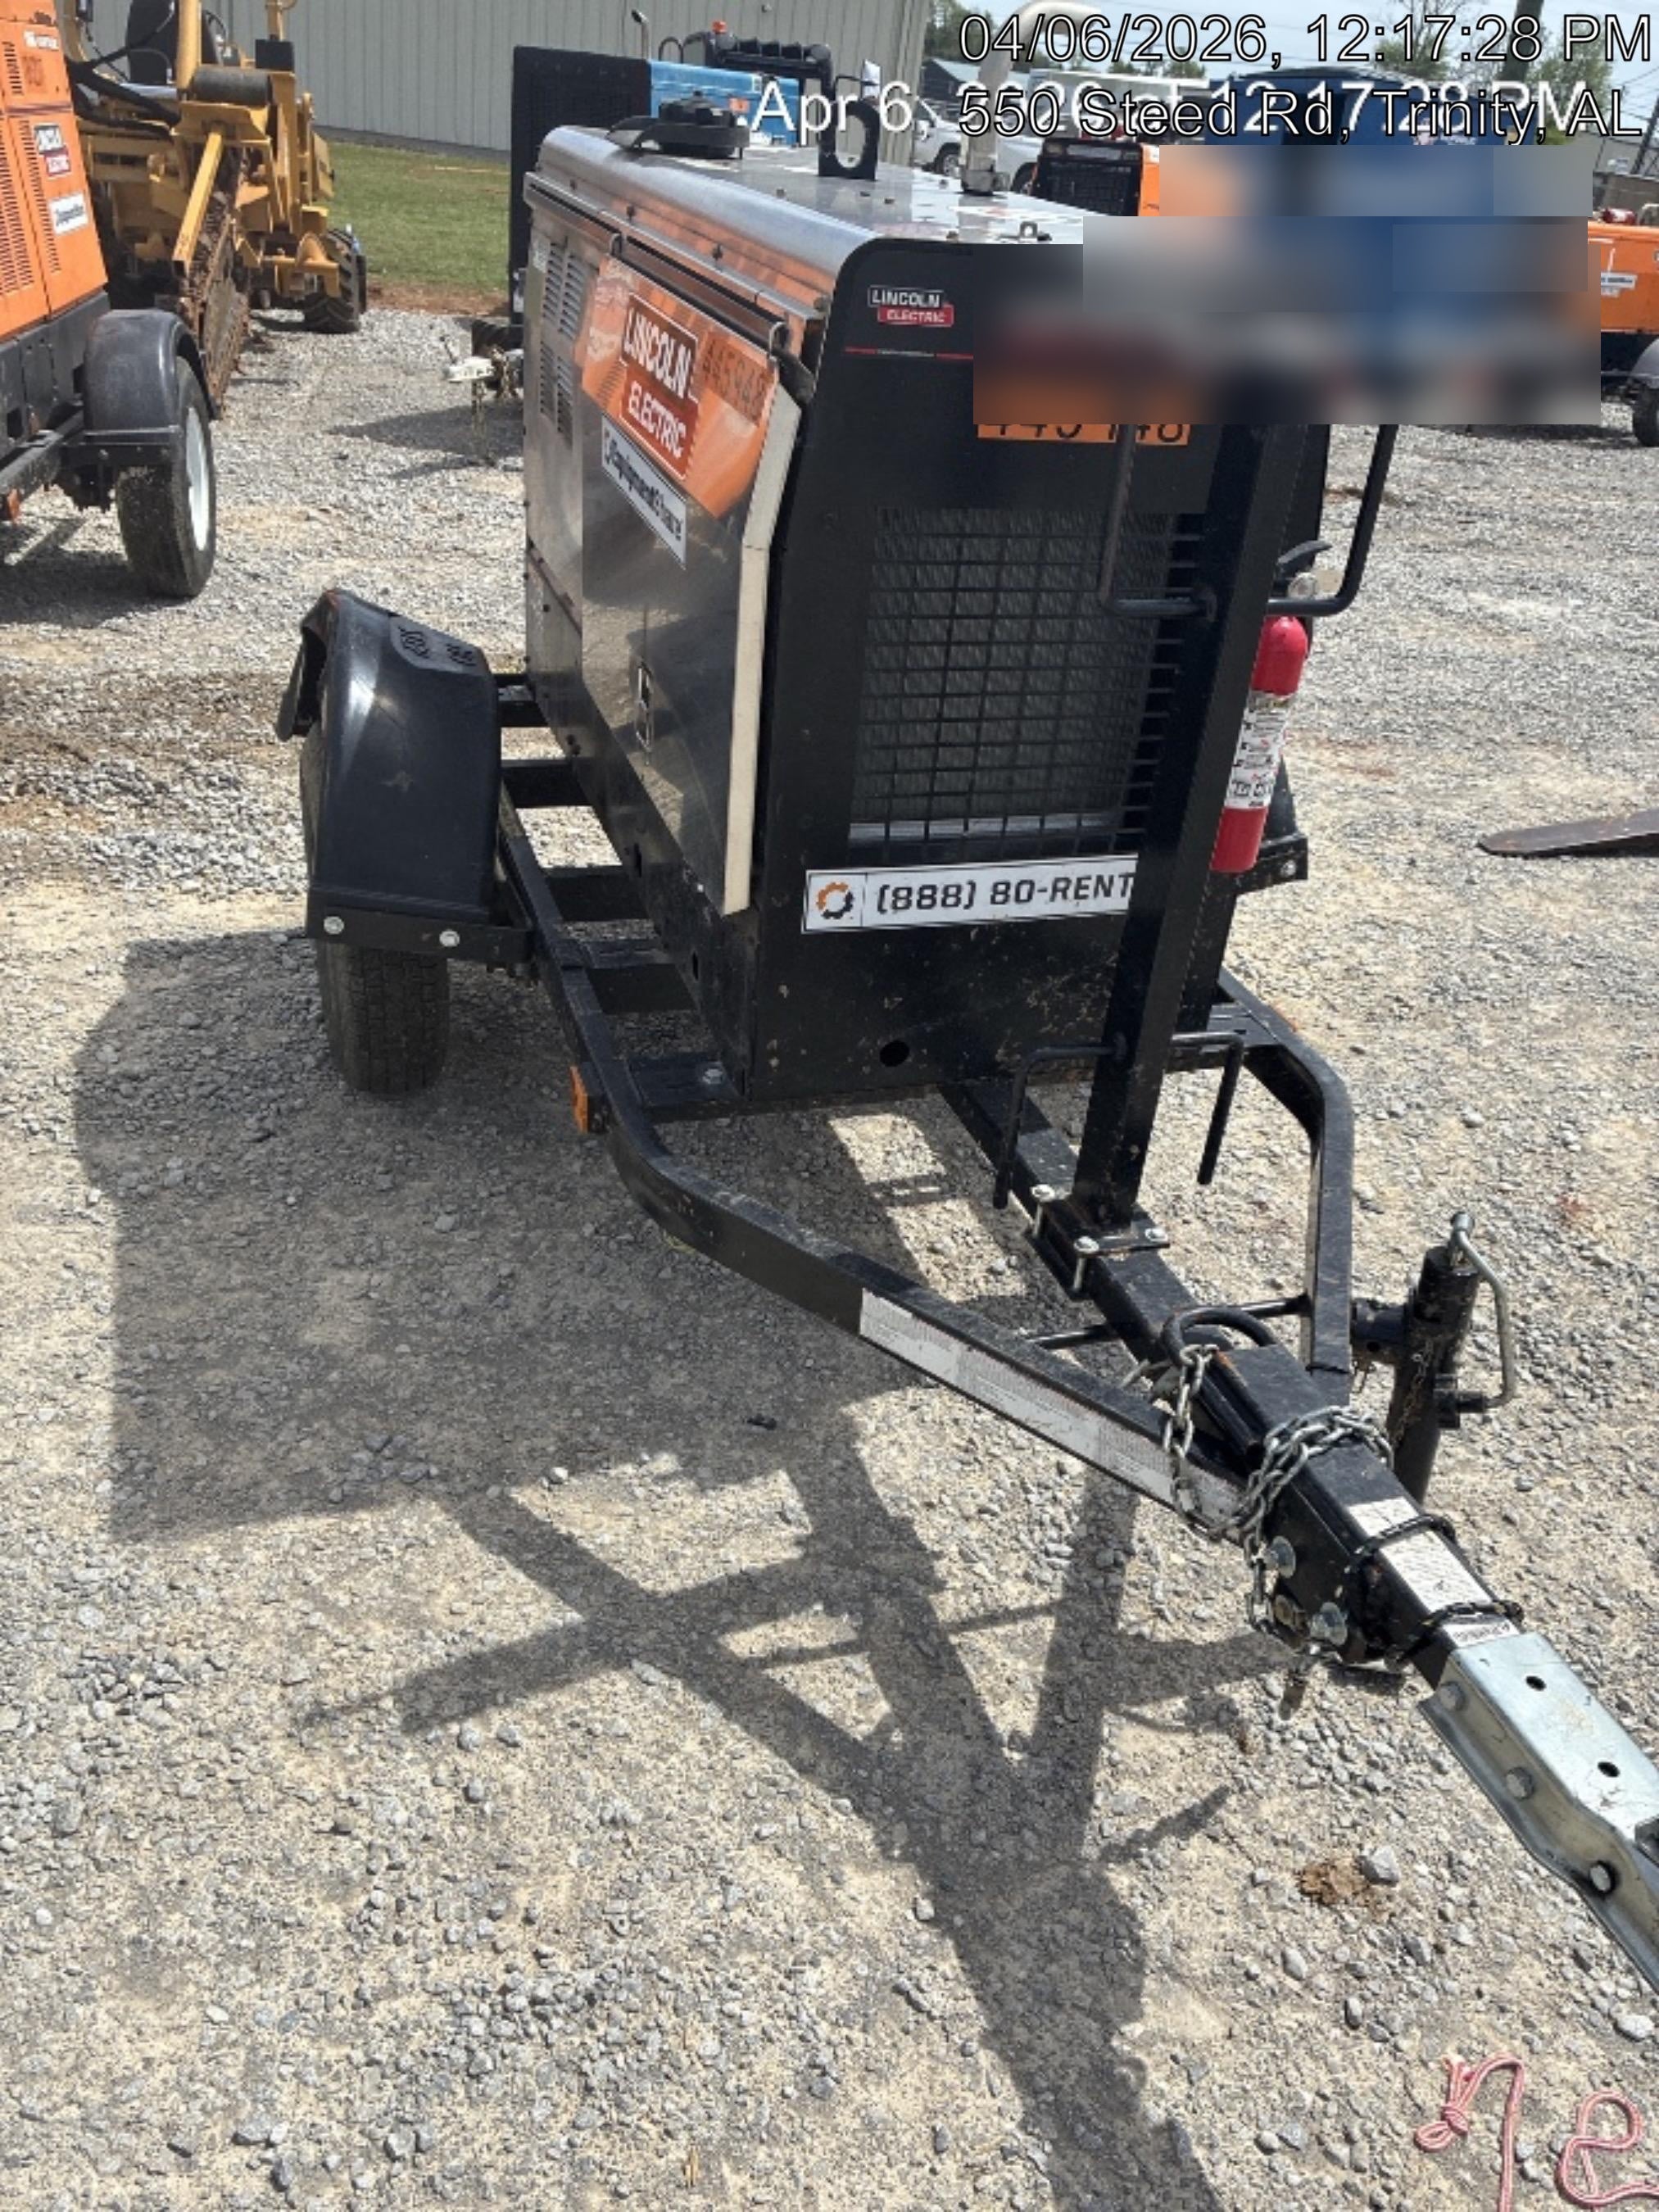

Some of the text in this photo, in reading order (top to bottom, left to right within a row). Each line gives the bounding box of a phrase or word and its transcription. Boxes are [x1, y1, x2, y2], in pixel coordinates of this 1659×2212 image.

[873, 289, 941, 308] LINCOLN
[886, 308, 945, 323] ELECTRIC
[623, 306, 693, 400] LINCOLN
[628, 380, 687, 459] ELECTRIC
[876, 872, 1135, 914] (888) 80-RENT
